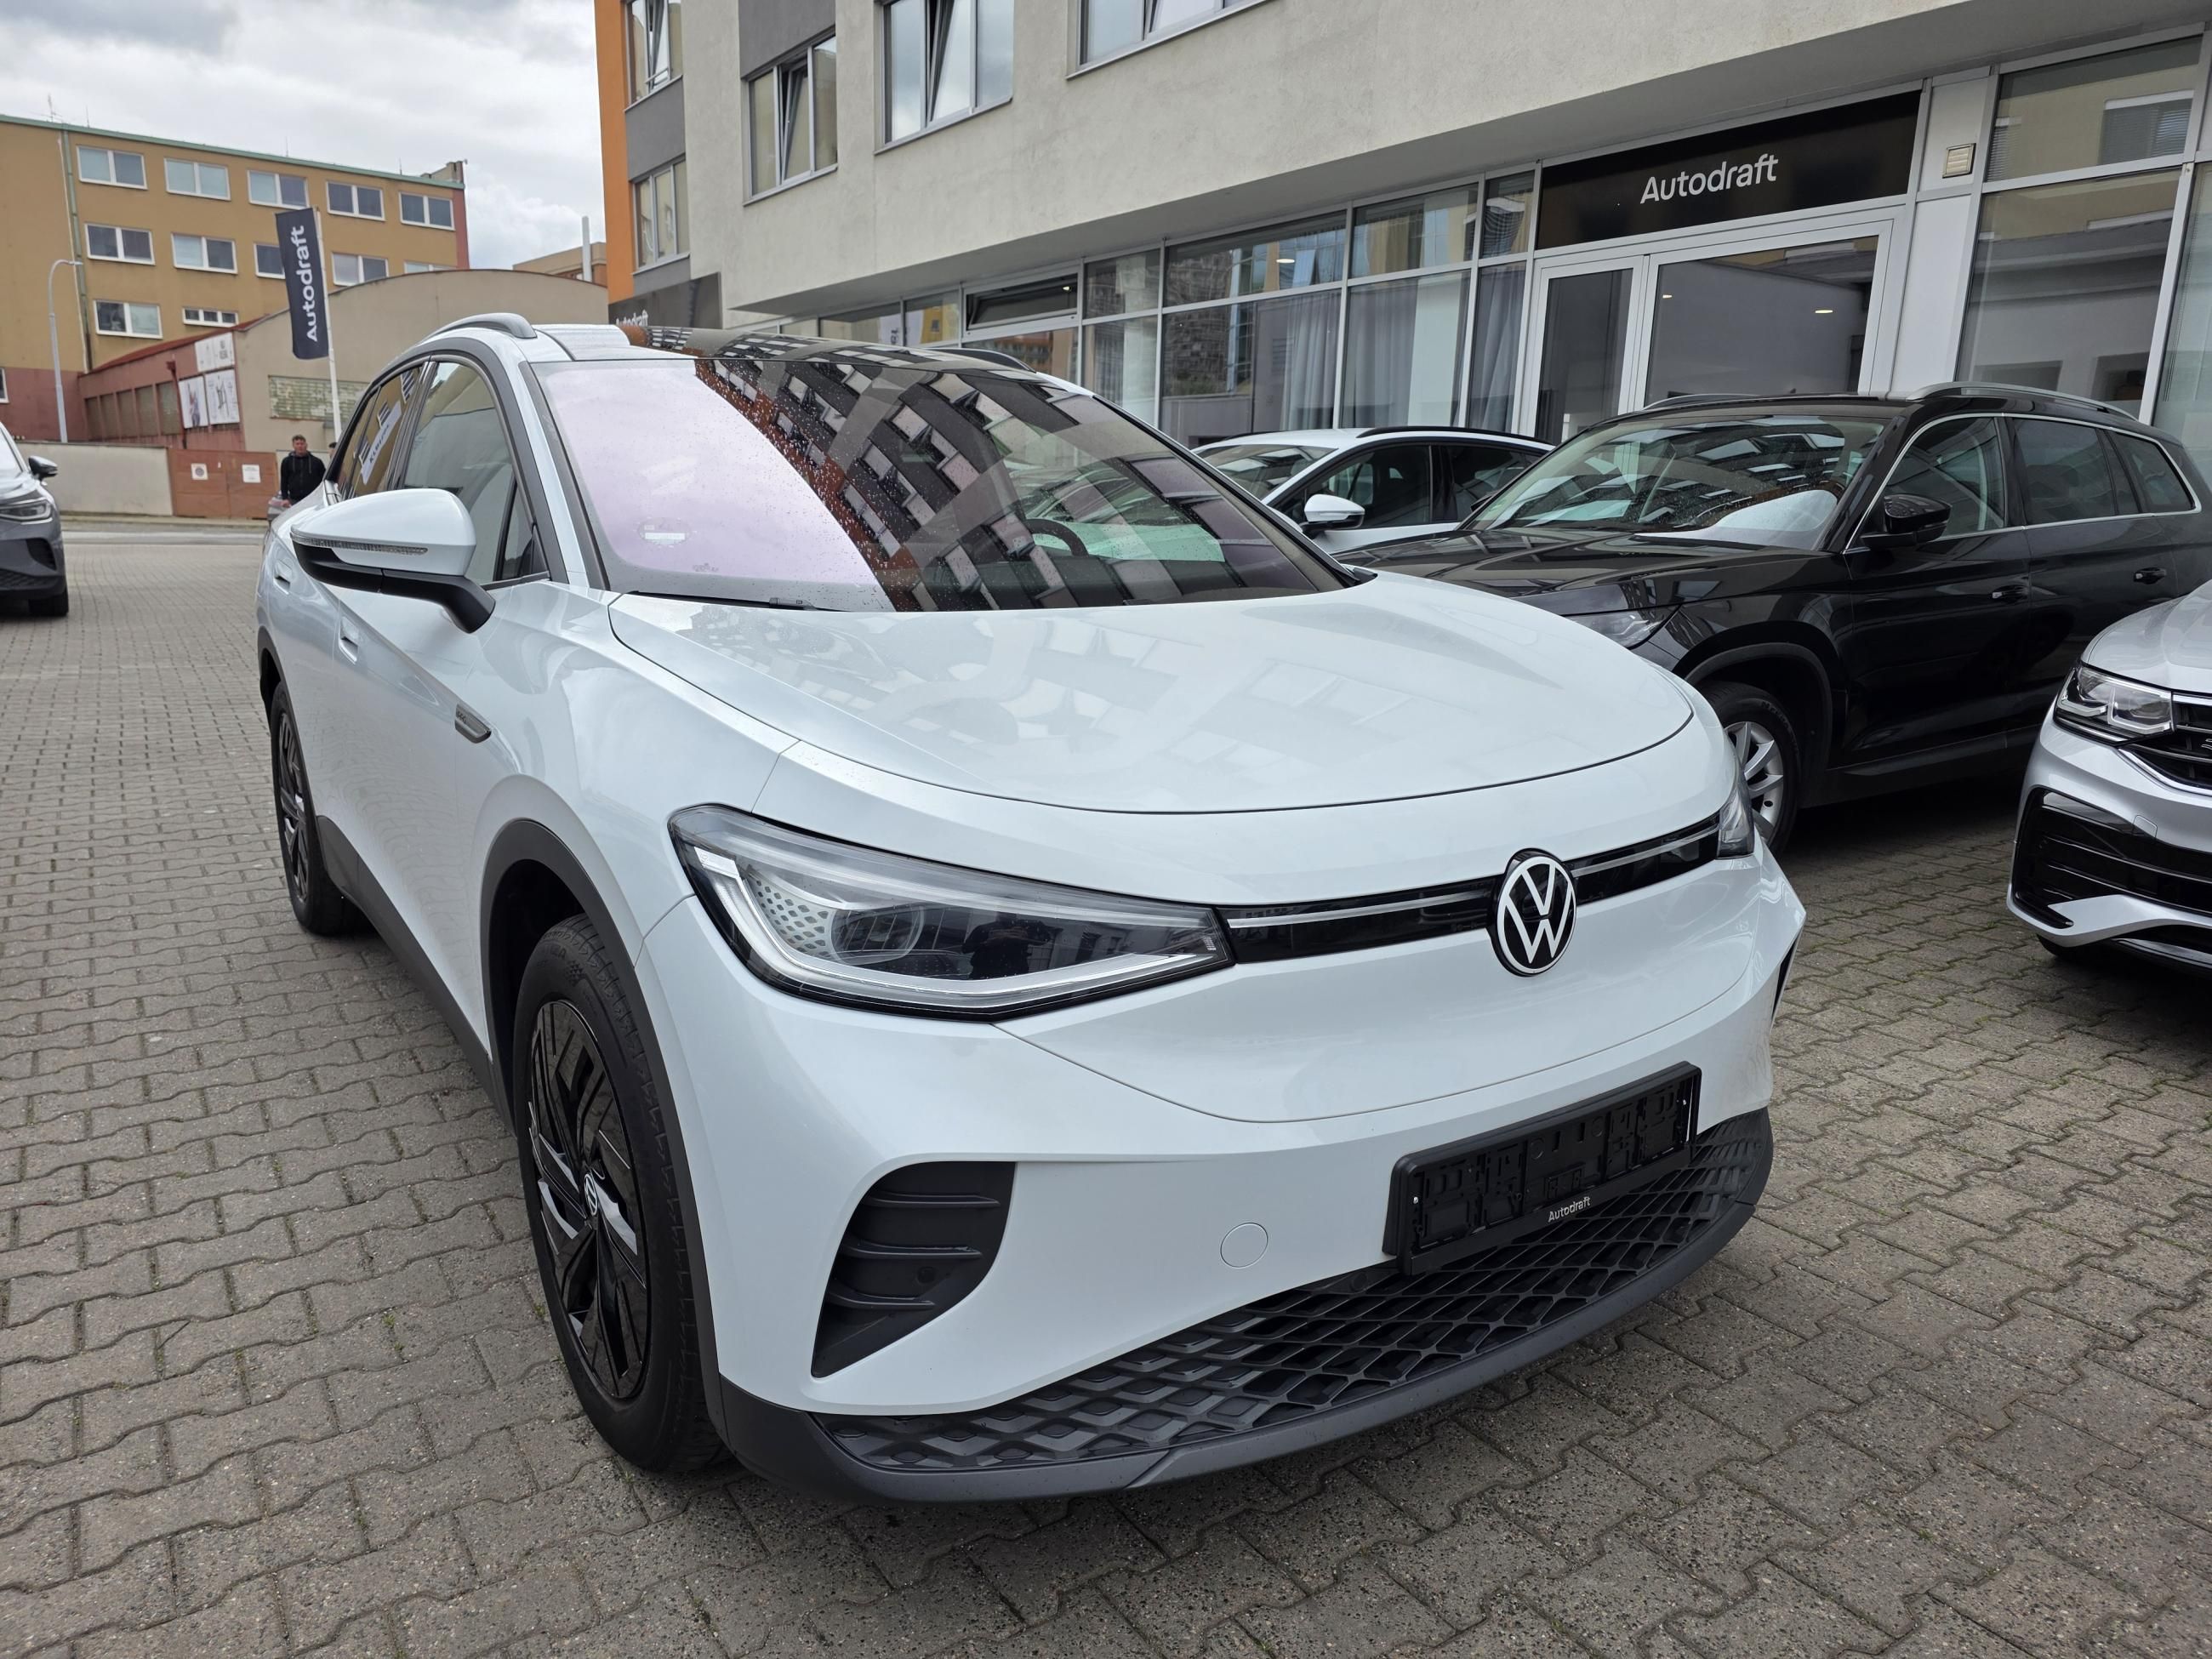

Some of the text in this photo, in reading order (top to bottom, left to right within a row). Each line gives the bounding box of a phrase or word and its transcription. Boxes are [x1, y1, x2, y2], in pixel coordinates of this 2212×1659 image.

[1640, 153, 1779, 204] Autodraft
[291, 225, 317, 341] Autodraft
[1548, 1196, 1591, 1223] Autodraft
